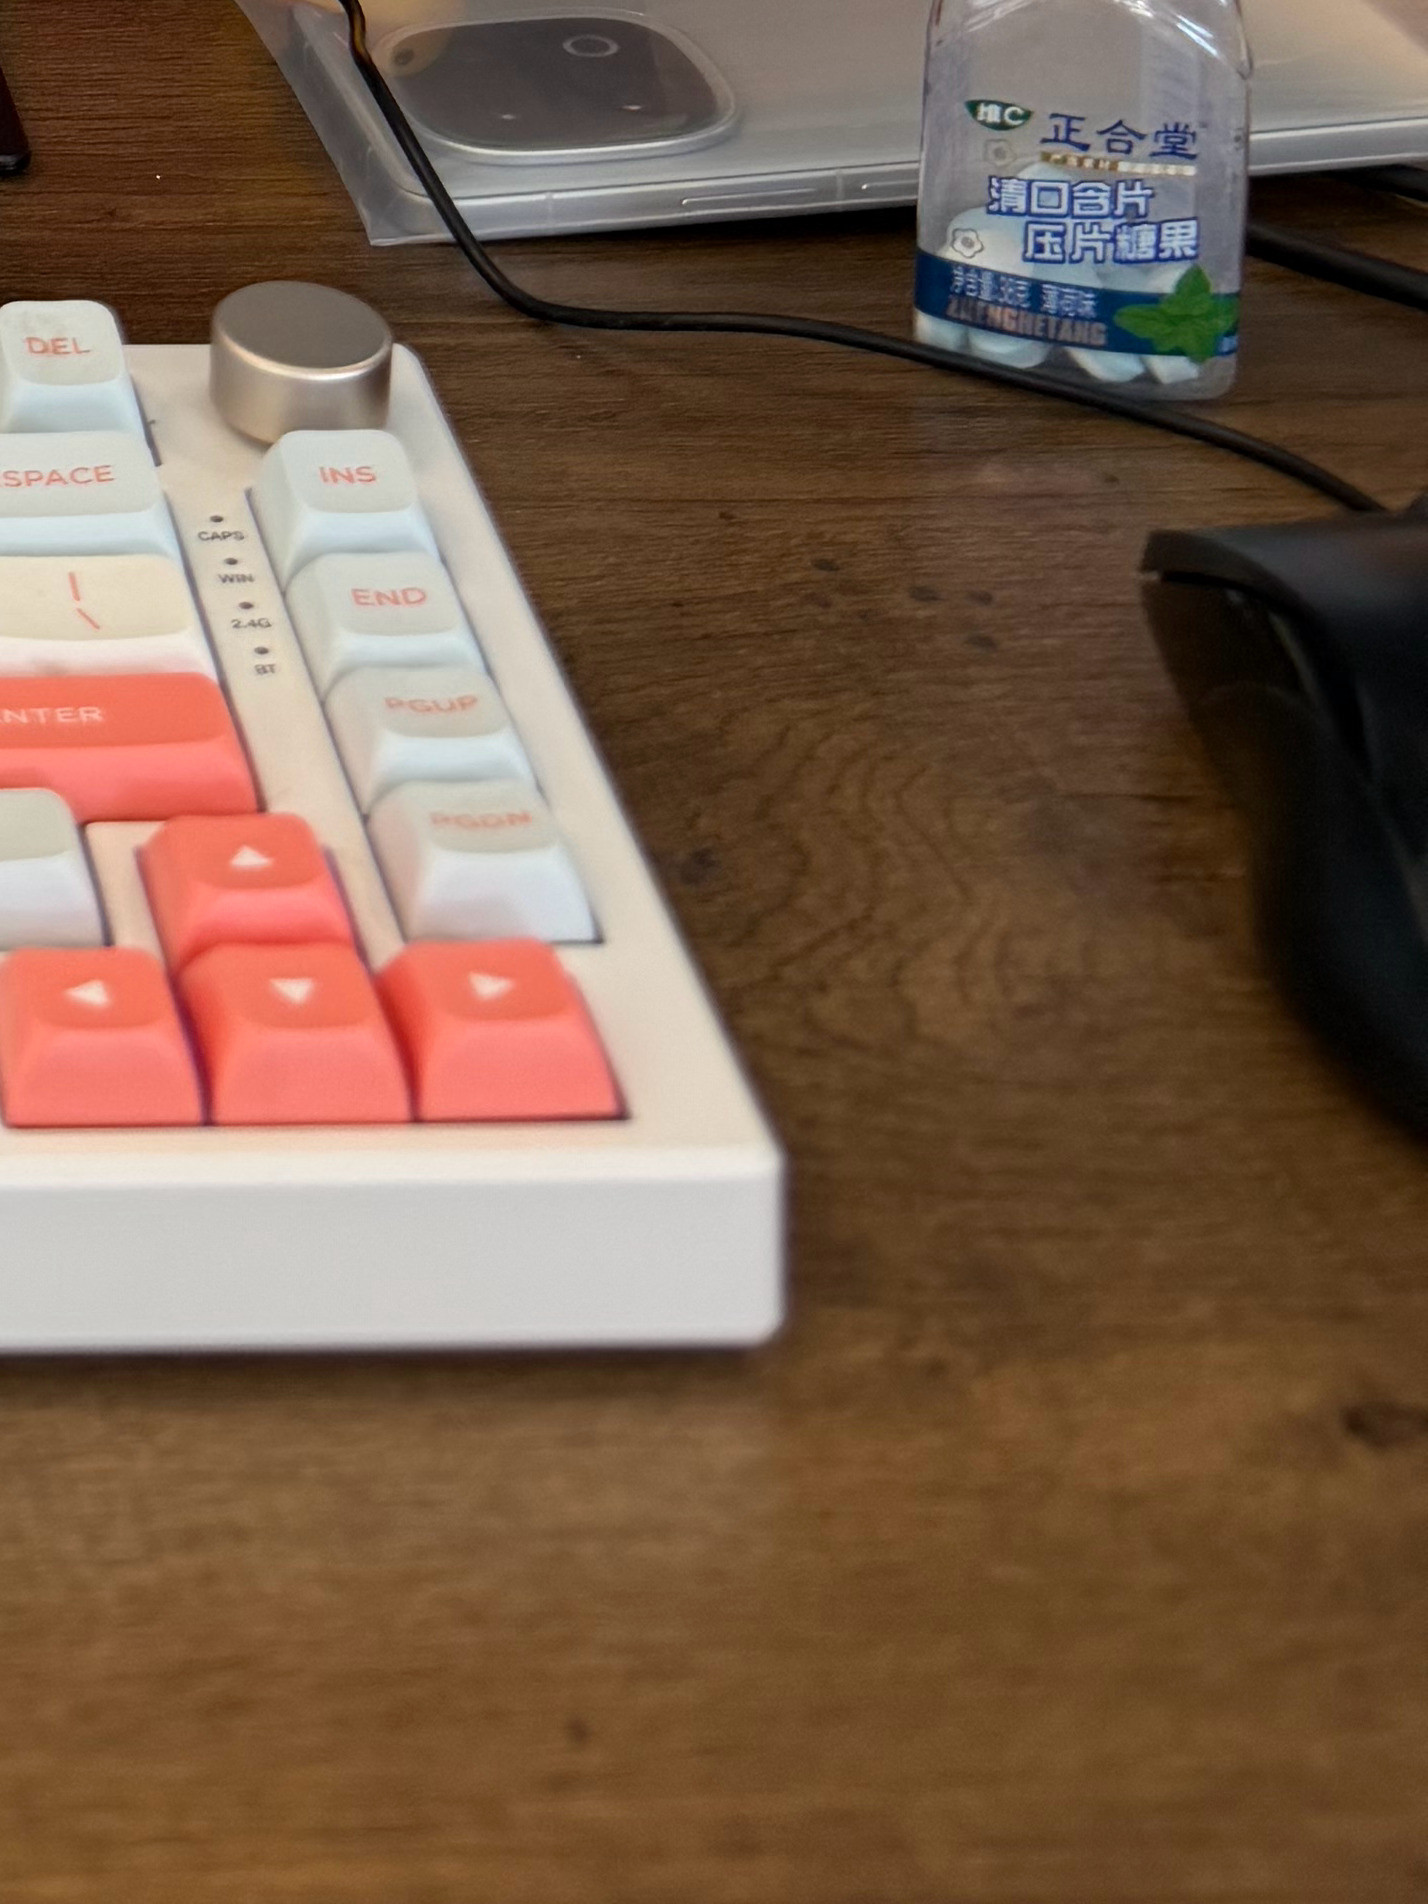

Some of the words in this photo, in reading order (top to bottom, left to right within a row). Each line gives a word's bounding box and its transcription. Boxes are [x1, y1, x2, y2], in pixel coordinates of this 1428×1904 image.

[1040, 112, 1198, 160] 正合堂
[986, 175, 1154, 219] 清口含片
[1022, 217, 1199, 264] 压片糖果
[24, 336, 87, 357] DEL
[320, 467, 376, 485] INS
[198, 531, 245, 542] CAPS
[219, 573, 254, 584] WIN
[352, 589, 427, 607] END
[231, 618, 272, 629] 2.4G
[255, 664, 276, 675] BT
